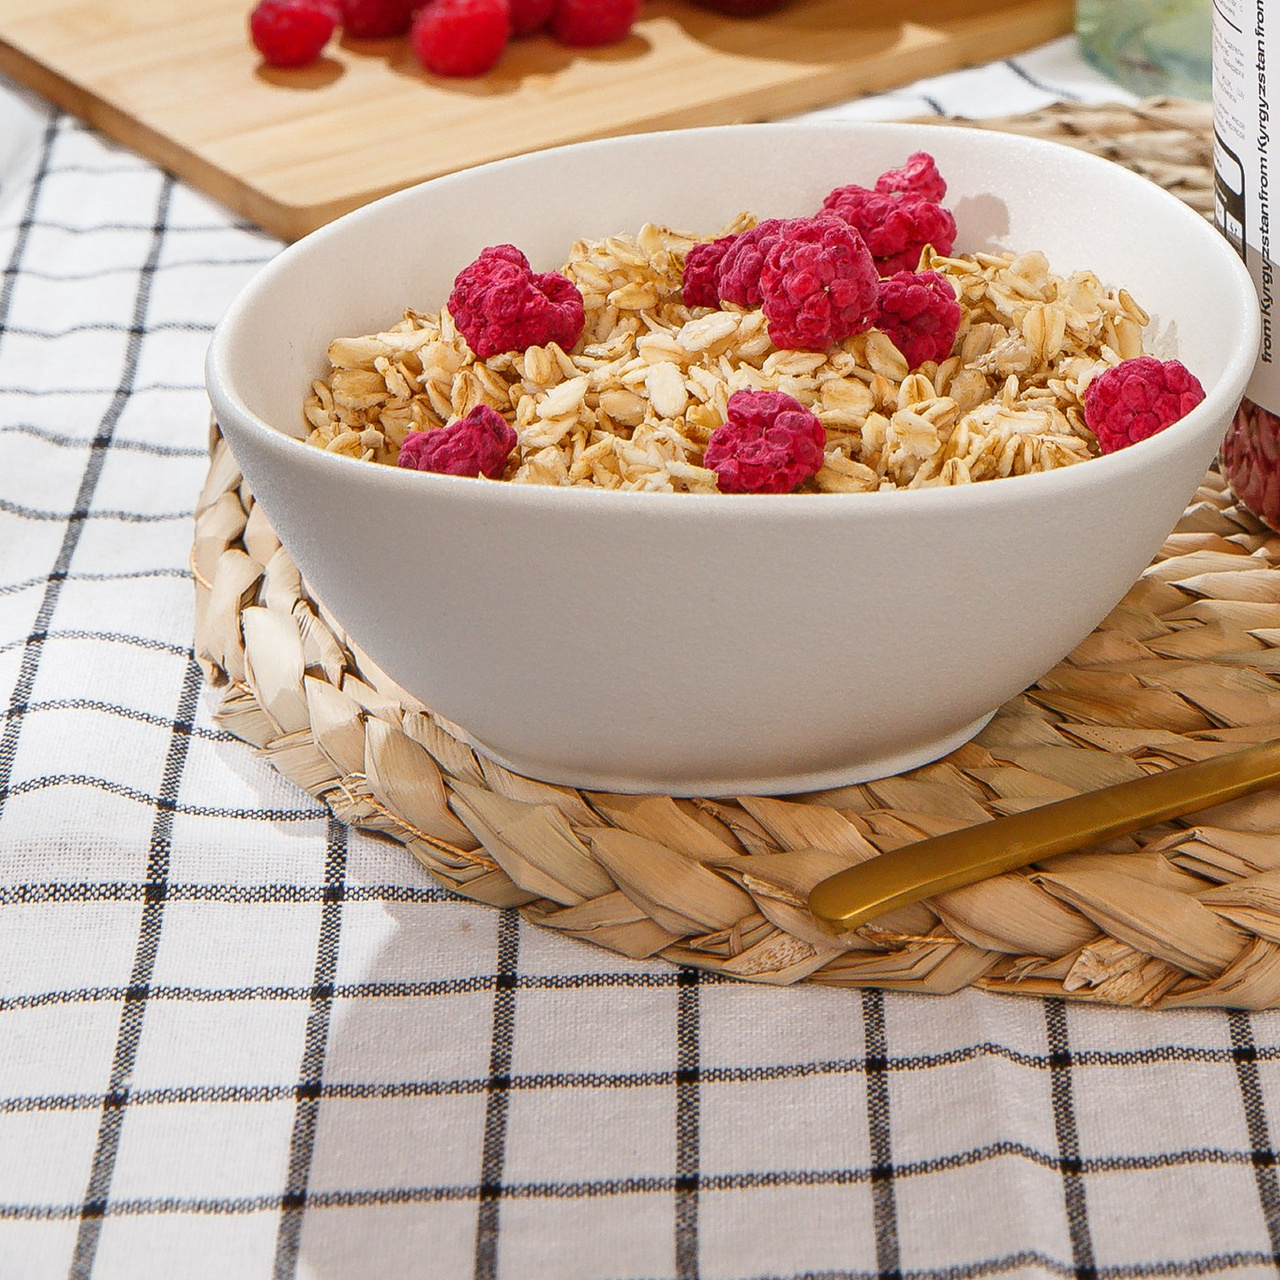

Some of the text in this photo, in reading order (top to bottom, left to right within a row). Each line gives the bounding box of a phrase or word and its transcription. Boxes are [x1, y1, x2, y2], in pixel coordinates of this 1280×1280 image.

[1255, 40, 1270, 154] Kyrgyzstan
[1258, 156, 1269, 202] from
[1259, 203, 1274, 317] Kyrgyzstan
[1261, 317, 1273, 364] from
